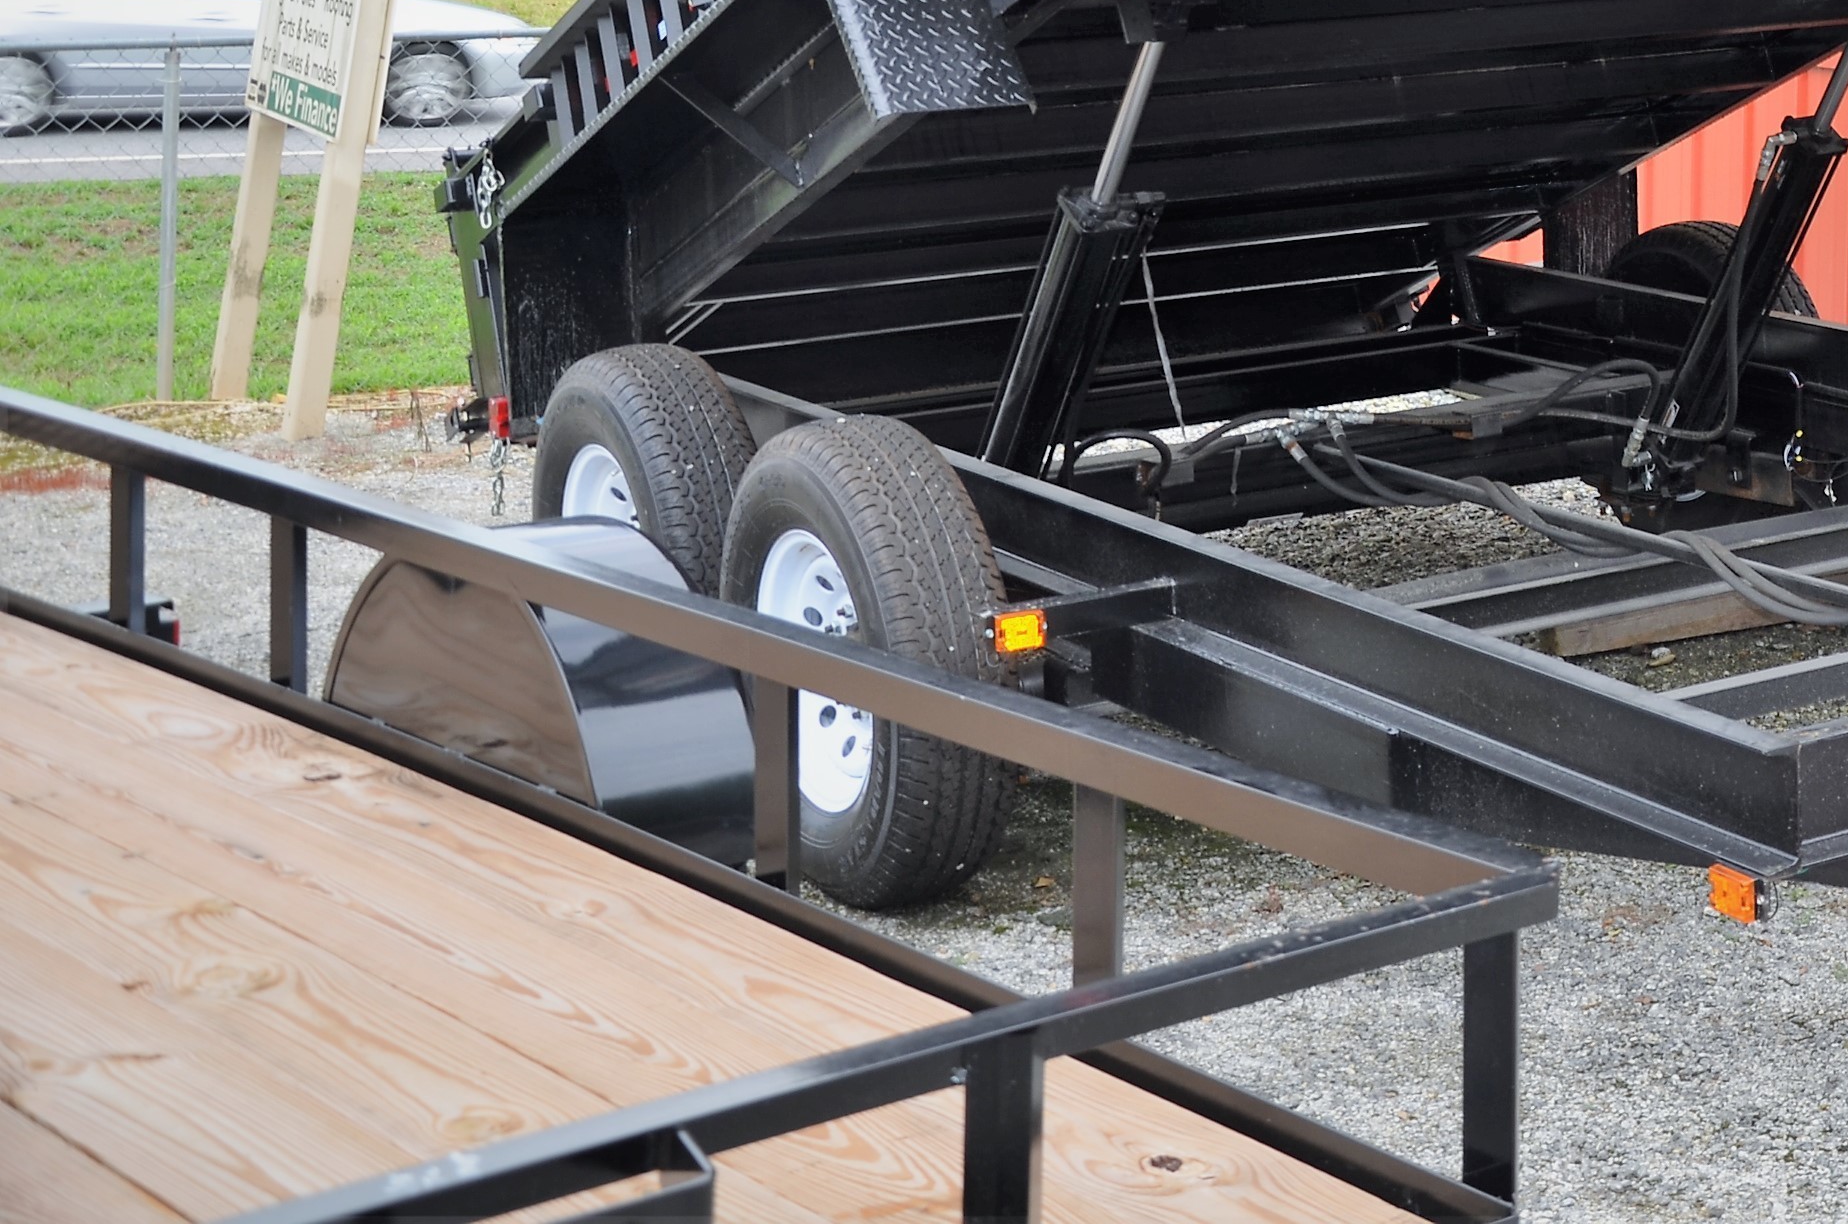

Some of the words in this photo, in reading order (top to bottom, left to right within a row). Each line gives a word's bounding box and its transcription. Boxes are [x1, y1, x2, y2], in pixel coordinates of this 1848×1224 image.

[277, 10, 296, 38] Parts
[296, 17, 303, 41] &
[303, 19, 329, 49] Service
[261, 36, 272, 61] for
[271, 42, 282, 65] all
[281, 47, 303, 74] makes
[304, 53, 311, 76] &
[293, 81, 339, 134] Finance
